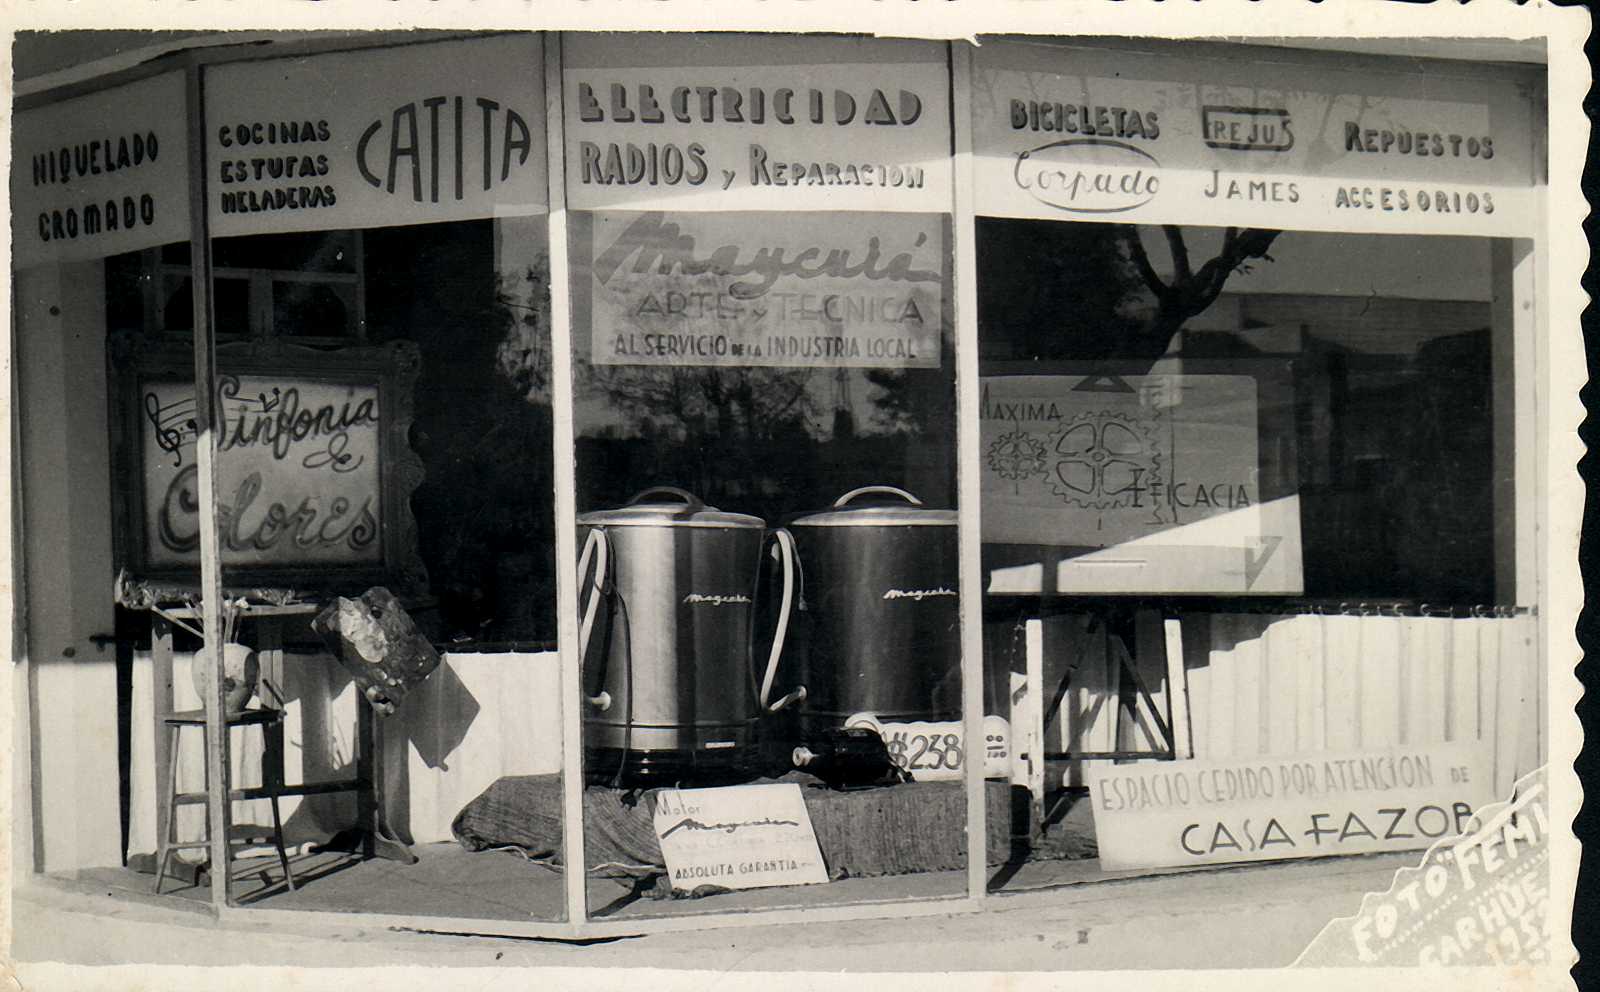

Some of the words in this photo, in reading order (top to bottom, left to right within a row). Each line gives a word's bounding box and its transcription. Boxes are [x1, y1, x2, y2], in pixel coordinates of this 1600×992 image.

[579, 81, 923, 127] ELECTRICIDAD
[1010, 99, 1161, 141] BICICLETAS
[219, 119, 331, 147] COCINAS
[356, 95, 532, 204] CATITA
[1344, 121, 1495, 160] REPUESTOS
[33, 130, 159, 187] NIQUELADO
[221, 154, 329, 183] ESTUFAS
[579, 140, 709, 187] RADIOS
[749, 143, 925, 189] REPARACION
[222, 185, 337, 214] HELADERAS
[1204, 170, 1301, 203] JAMES
[1334, 186, 1495, 214] ACCESORIOS
[38, 193, 154, 242] CROMADO
[615, 334, 642, 357] AL
[644, 334, 728, 358] SERVICIO
[767, 335, 860, 359] INDUSTRIA
[866, 337, 917, 359] LOCAL
[888, 731, 965, 771] $238
[1099, 771, 1190, 812] ESPACIO
[1197, 766, 1274, 803] CEDIDO
[1279, 763, 1317, 795] POR
[1324, 755, 1434, 793] ATENCION
[1450, 765, 1470, 784] DE
[1180, 817, 1298, 857] CASA
[675, 864, 735, 880] ABSOLUTA
[739, 859, 798, 875] GARANTIA
